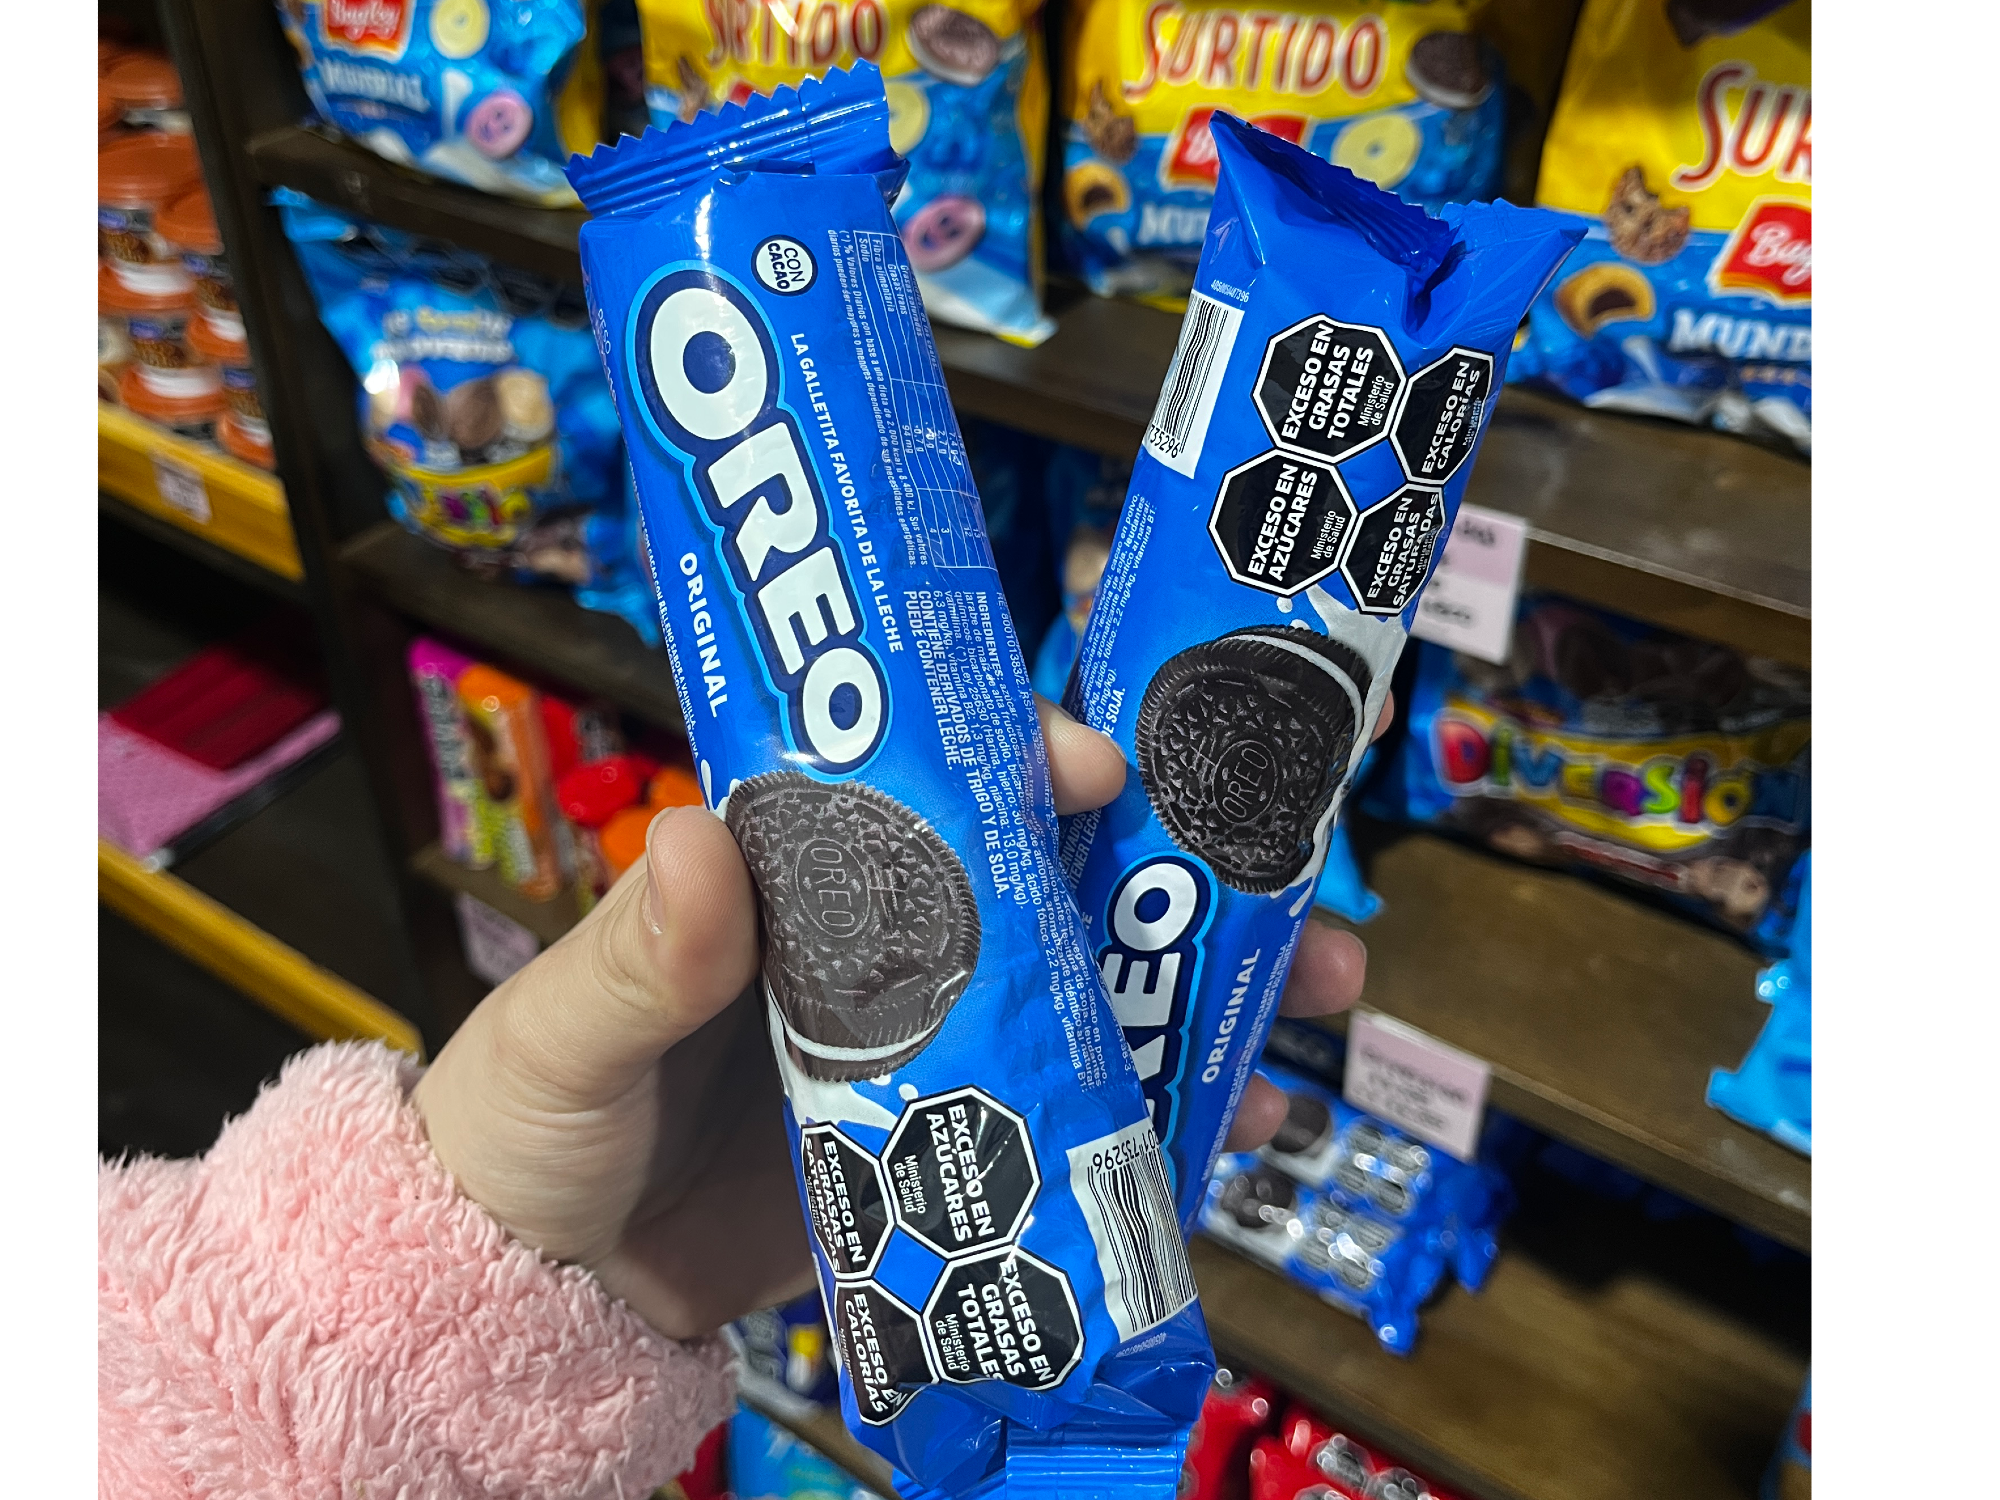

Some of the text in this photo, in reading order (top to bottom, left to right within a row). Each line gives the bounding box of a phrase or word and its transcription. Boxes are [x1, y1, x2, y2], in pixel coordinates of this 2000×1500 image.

[1123, 2, 1382, 98] SURTIDO
[767, 242, 790, 290] CACAO
[783, 247, 805, 282] CON
[827, 229, 841, 257] diarios
[843, 244, 853, 254] %
[858, 238, 870, 262] Sodio
[833, 258, 848, 287] pueden
[846, 256, 858, 288] Valores
[872, 239, 895, 312] Fibra alimentaria
[887, 263, 908, 315] Grasas trans
[900, 264, 913, 293] Grasas
[846, 304, 860, 338] mayores
[852, 290, 866, 319] Diarios
[861, 321, 872, 336] con
[856, 347, 872, 380] menores
[865, 338, 877, 358] base
[873, 366, 884, 382] una
[878, 384, 889, 406] dieta
[1282, 323, 1334, 438] EXCESO EN
[1309, 346, 1350, 429] GRASAS
[1328, 348, 1373, 438] TOTALES
[1358, 375, 1385, 426] Ministerio
[1370, 380, 1394, 426] de Salud
[866, 382, 886, 434] dependiendo
[883, 407, 892, 418] de
[1422, 361, 1470, 473] EXCESO EN
[1437, 370, 1480, 469] CALORÍAS
[880, 436, 889, 447] de
[892, 447, 903, 466] kcal
[901, 424, 914, 454] 94 mg
[790, 333, 903, 652] LA GALLETITA FAVORITA DE LA LECHE
[884, 465, 903, 516] necesidades
[651, 286, 883, 760] OREO
[909, 516, 920, 531] Sus
[963, 526, 972, 537] 12
[1248, 463, 1298, 574] EXCESO EN
[1270, 472, 1317, 580] AZÚCARES
[1310, 510, 1336, 559] Ministerio
[1322, 515, 1346, 558] de Salud
[915, 533, 928, 565] valores
[1367, 497, 1413, 598] EXCESO EN
[1388, 512, 1420, 587] GRASAS
[1393, 491, 1441, 606] SATURADAS
[658, 600, 675, 642] RELLENO
[668, 643, 683, 675] SABOR
[680, 553, 727, 715] ORIGINAL
[1084, 540, 1139, 699] amonio, al
[1085, 525, 1152, 725] mg/kg, ácido fólico: mg/kg, vitamina
[904, 590, 961, 770] PUEDE CONTENER LECHE.
[960, 665, 973, 686] Ley
[976, 591, 1030, 759] INGREDIENTES: azúcar, harina
[1092, 669, 1116, 729] 13,0 mg/kg).
[968, 686, 989, 721] 25630
[1105, 688, 1125, 723] SOJA.
[918, 590, 1010, 898] CONTIENE DERIVADOS DE TRIGO Y DE SOJA.
[932, 590, 1028, 908] 6,3 mg/kg, vitamina B2: 1,3 mg/kg, niacina: 13,0 mg/kg).
[980, 724, 1001, 769] (Harina,
[962, 591, 1085, 989] jarabe de alta fructosa, lecitina de
[996, 770, 1017, 807] hierro:
[1222, 748, 1268, 818] OREO
[954, 591, 1085, 1041] químicos: bicarbonato de sodio, de amonio, aromatizante idéntico al
[1011, 810, 1024, 825] 30
[1016, 828, 1032, 871] mg/kg,
[810, 843, 854, 927] OREO
[1025, 873, 1042, 905] ácido
[1049, 971, 1065, 1014] mg/kg,
[1087, 988, 1101, 1043] cacao en
[1202, 950, 1259, 1082] ORIGINAL
[1062, 1016, 1082, 1069] vitamina
[893, 1162, 918, 1213] de Salud
[904, 1155, 927, 1214] Ministerio
[927, 1114, 971, 1240] AZÚCARES
[949, 1105, 995, 1236] EXCESO EN
[802, 1137, 840, 1272] SATURADAS
[816, 1159, 844, 1247] GRASAS
[824, 1141, 866, 1263] EXCESO EN
[935, 1320, 960, 1370] de Salud
[945, 1313, 970, 1371] Ministerio
[958, 1284, 1003, 1380] TOTALES
[982, 1284, 1025, 1375] GRASAS
[1000, 1259, 1055, 1381] EXCESO EN
[846, 1300, 887, 1411] CALORÍAS
[854, 1294, 905, 1406] EXCESO EN
